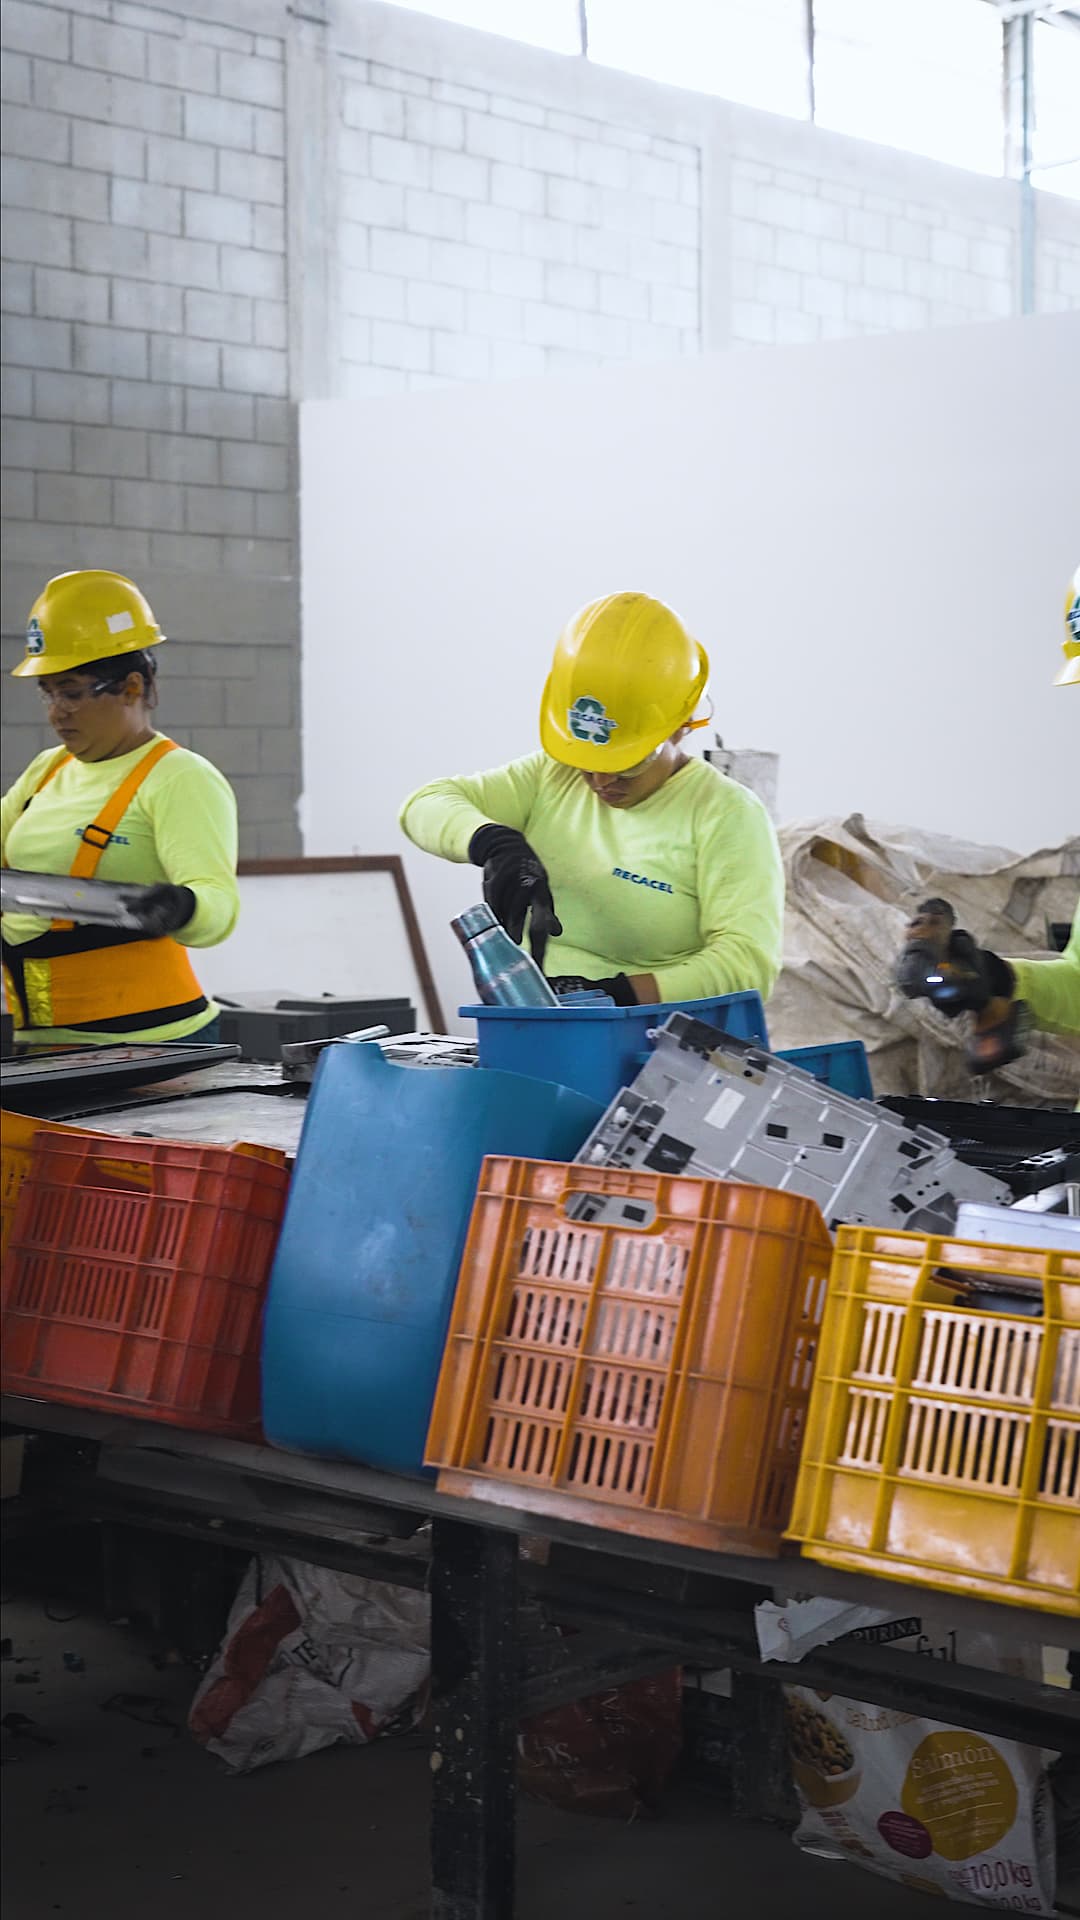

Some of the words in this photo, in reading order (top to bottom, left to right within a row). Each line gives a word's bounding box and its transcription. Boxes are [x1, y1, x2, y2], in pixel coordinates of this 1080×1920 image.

[612, 867, 674, 894] RECACEL
[848, 1619, 920, 1642] PURINA
[911, 1744, 996, 1778] Salmón
